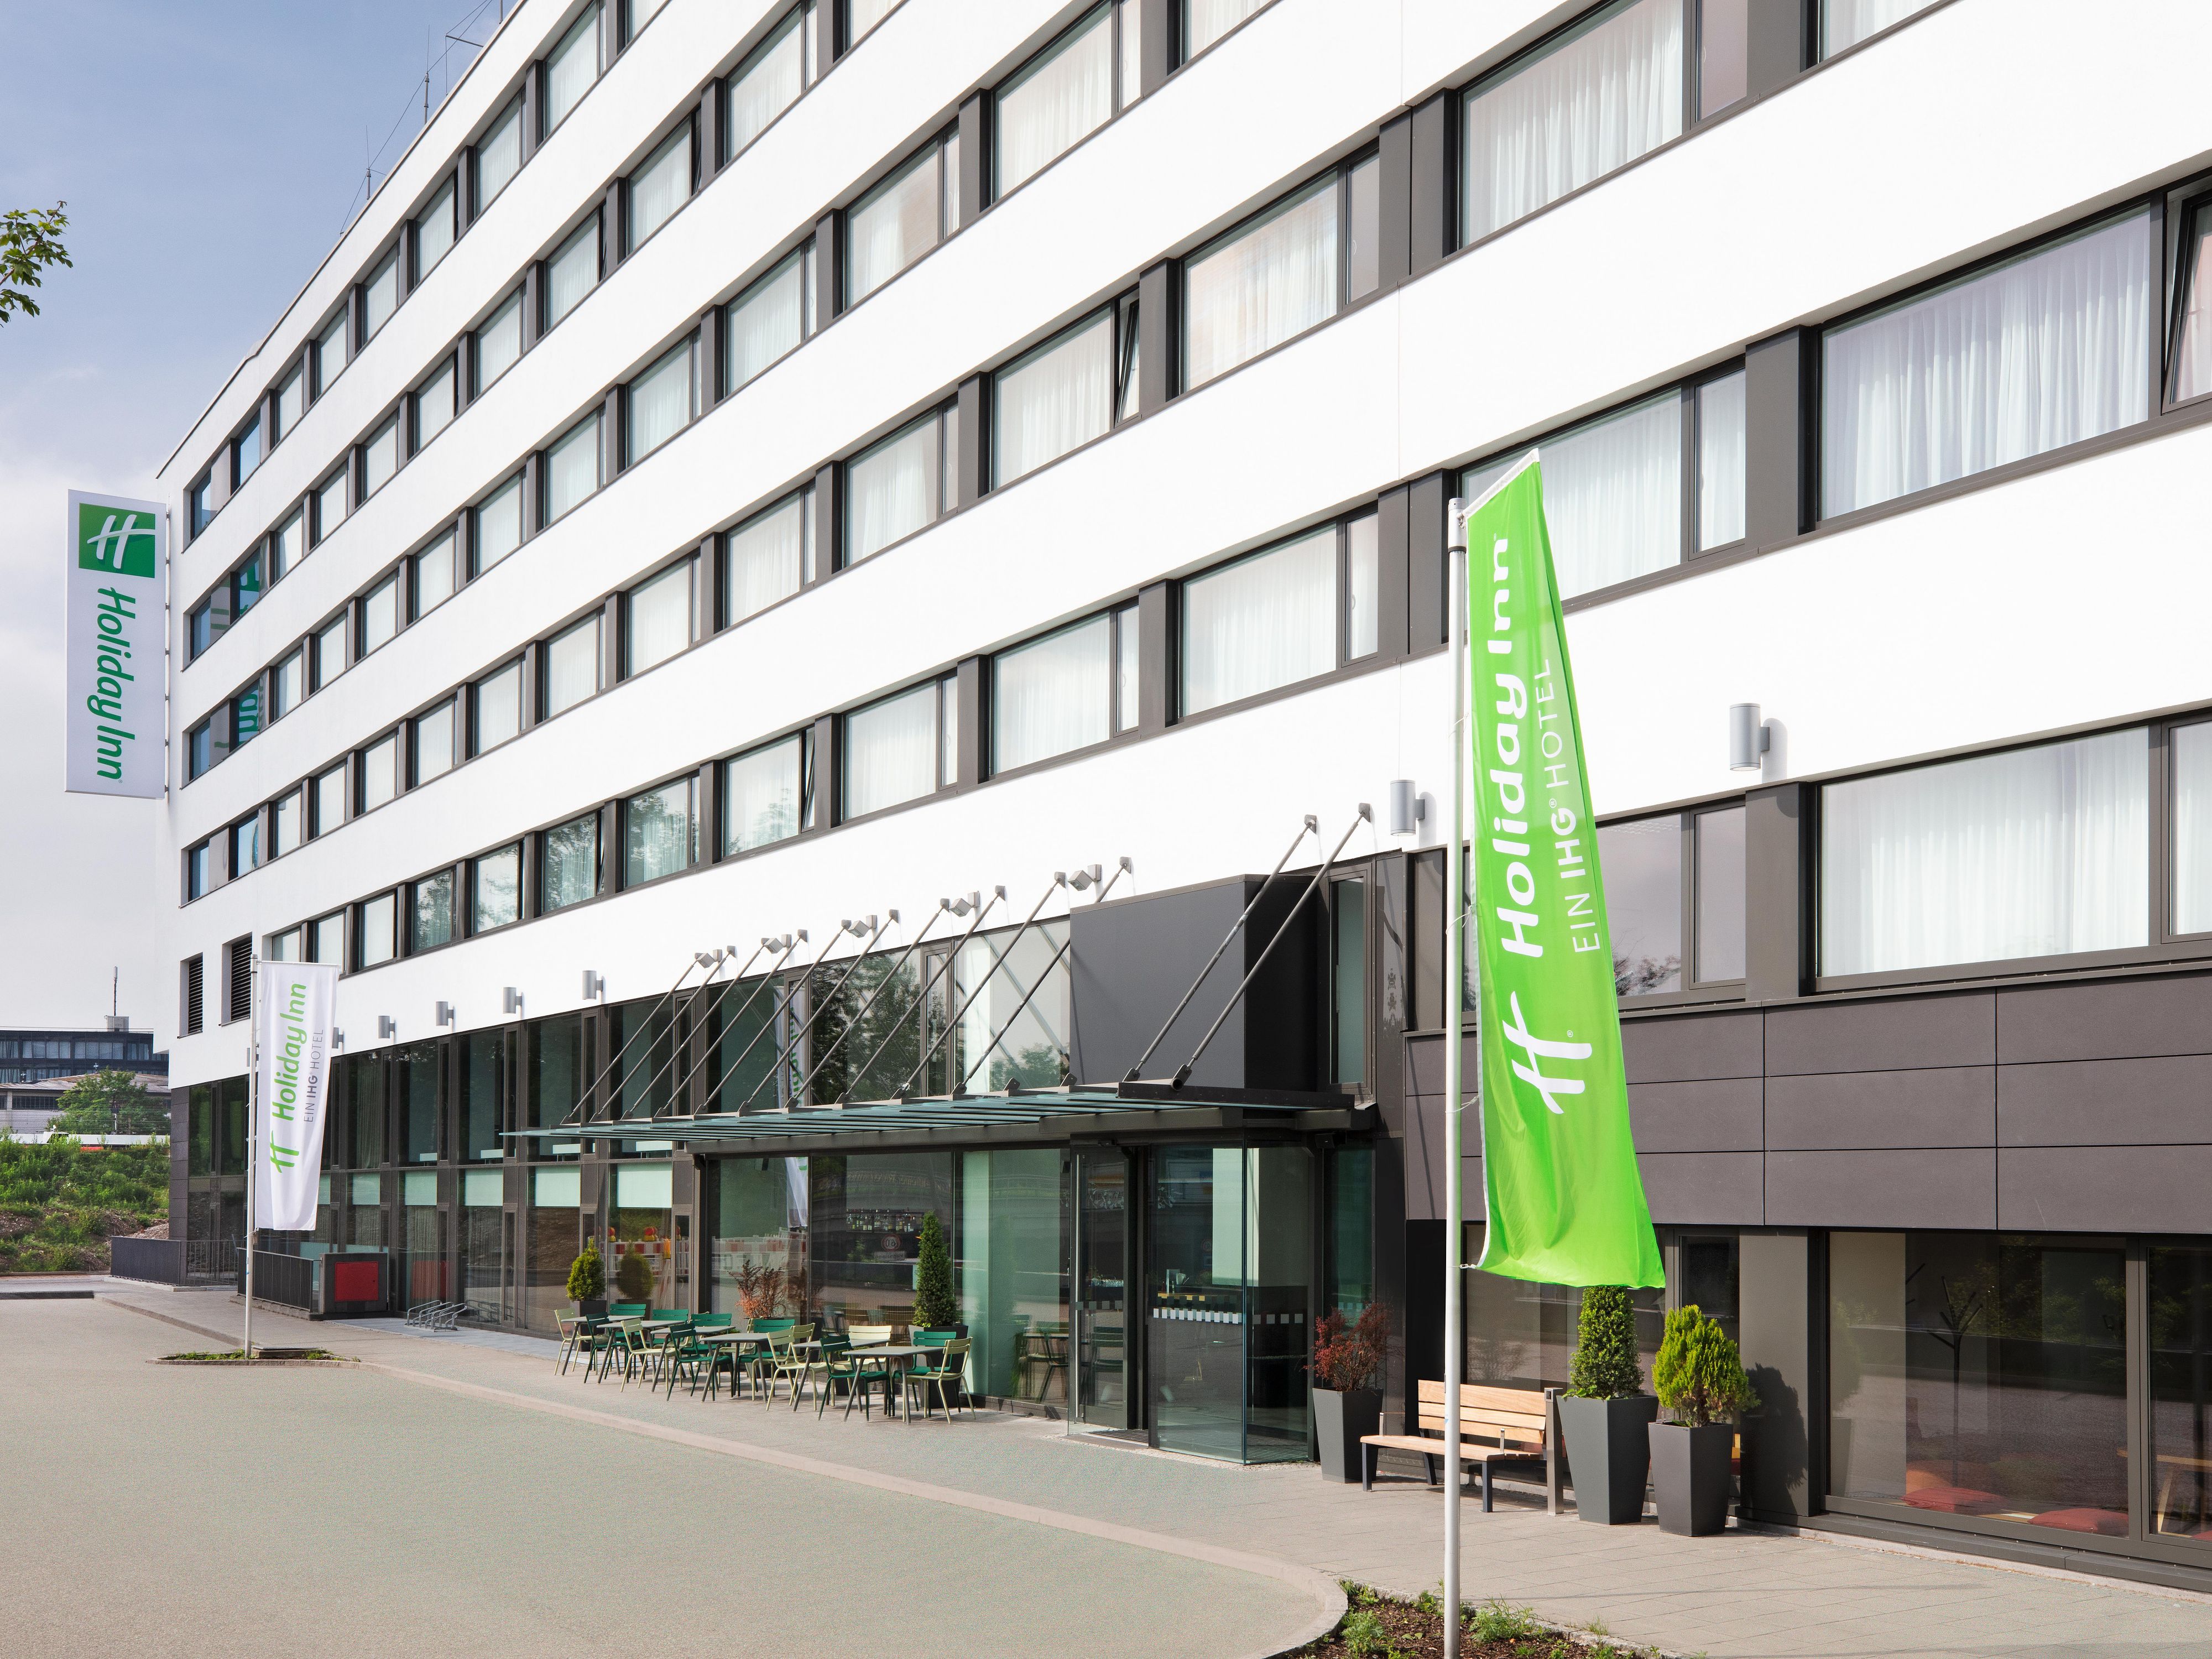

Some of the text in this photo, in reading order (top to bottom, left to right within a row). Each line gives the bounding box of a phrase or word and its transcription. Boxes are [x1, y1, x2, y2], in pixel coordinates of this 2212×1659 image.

[87, 587, 136, 722] Holiday
[1534, 659, 1569, 789] HOTEL
[1490, 673, 1543, 958] Holiday
[1564, 893, 1600, 953] EIN
[271, 1027, 307, 1121] Holiday
[304, 1102, 314, 1123] EIN
[309, 1029, 324, 1071] HOTEL
